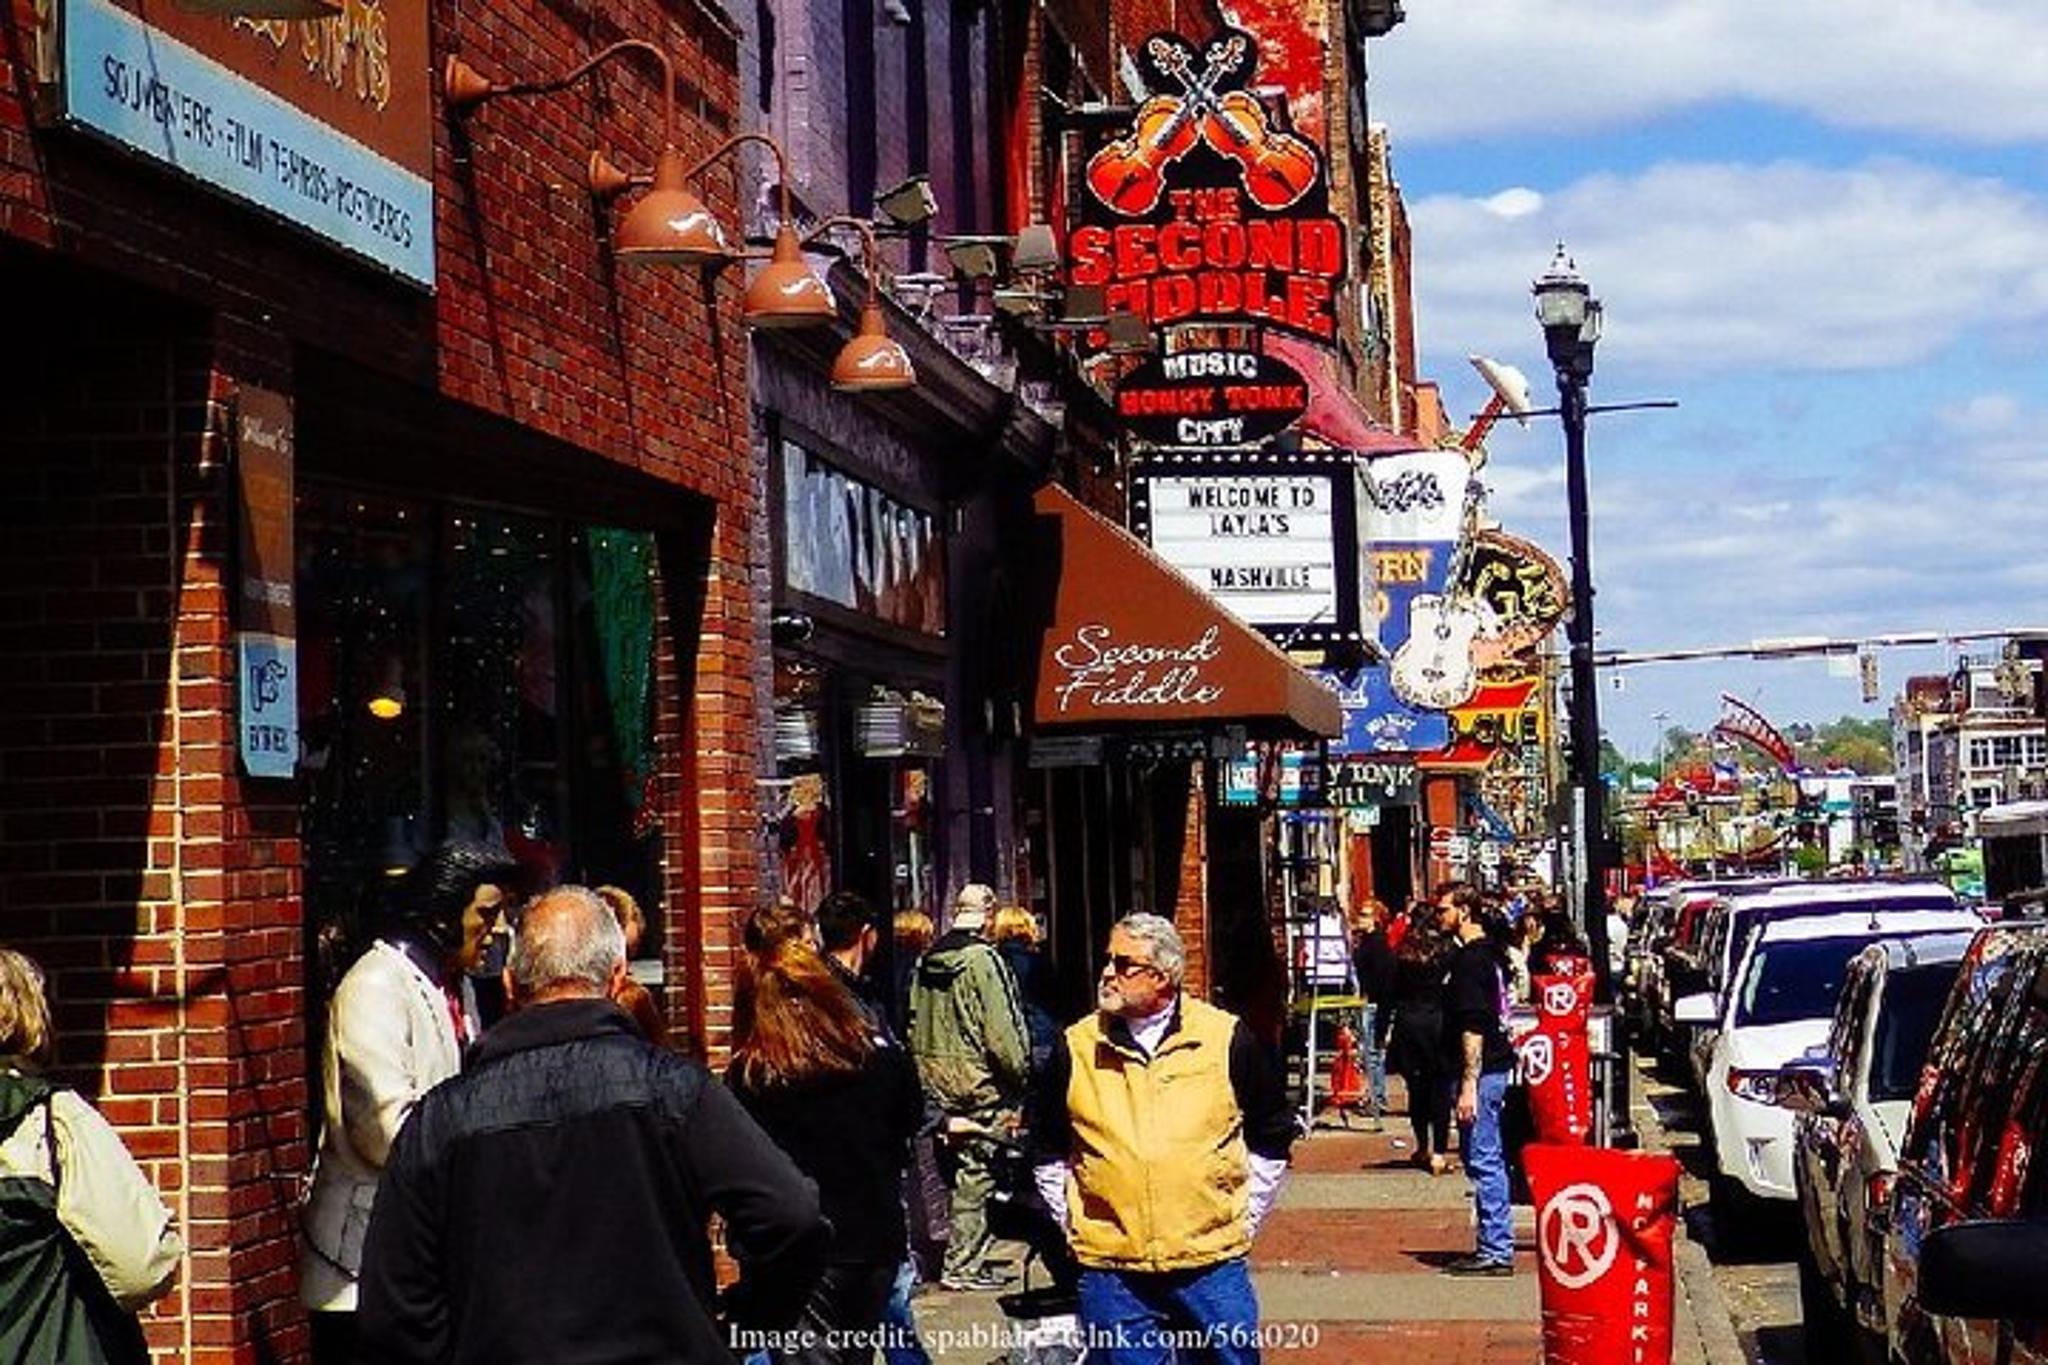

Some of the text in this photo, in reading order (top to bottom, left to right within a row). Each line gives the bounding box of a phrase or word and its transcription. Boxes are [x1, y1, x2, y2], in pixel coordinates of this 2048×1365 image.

[1169, 187, 1240, 220] THE
[1070, 219, 1342, 285] SECOND
[1162, 352, 1258, 379] MUSIC
[1225, 386, 1304, 410] TONK
[1177, 418, 1244, 444] CITY
[1188, 487, 1316, 508] WELCOME TO
[1211, 514, 1291, 535] LAYLA'S
[1211, 567, 1310, 588] NASHVILLE
[1054, 625, 1221, 672] Second
[1054, 666, 1225, 712] Fiddle
